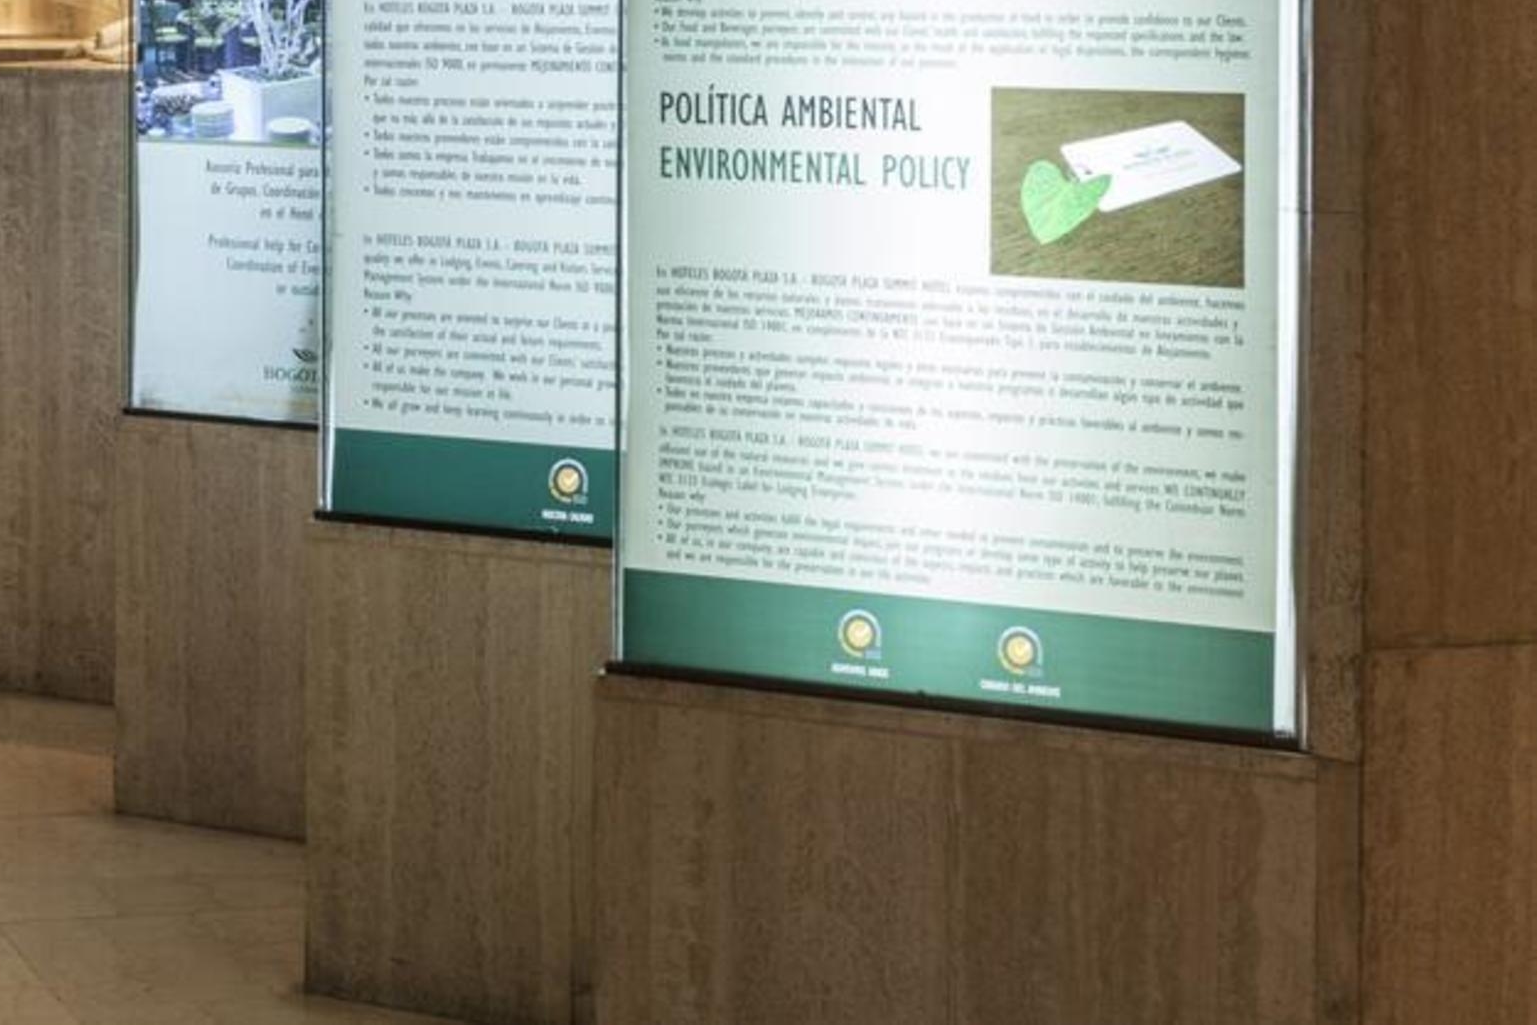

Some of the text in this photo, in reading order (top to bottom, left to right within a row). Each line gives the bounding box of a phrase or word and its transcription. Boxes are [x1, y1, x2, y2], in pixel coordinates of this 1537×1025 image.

[659, 85, 766, 126] POLÍTICA
[781, 95, 921, 132] AMBIENTAL
[659, 146, 970, 191] ENVIRONMENTAL POLICY
